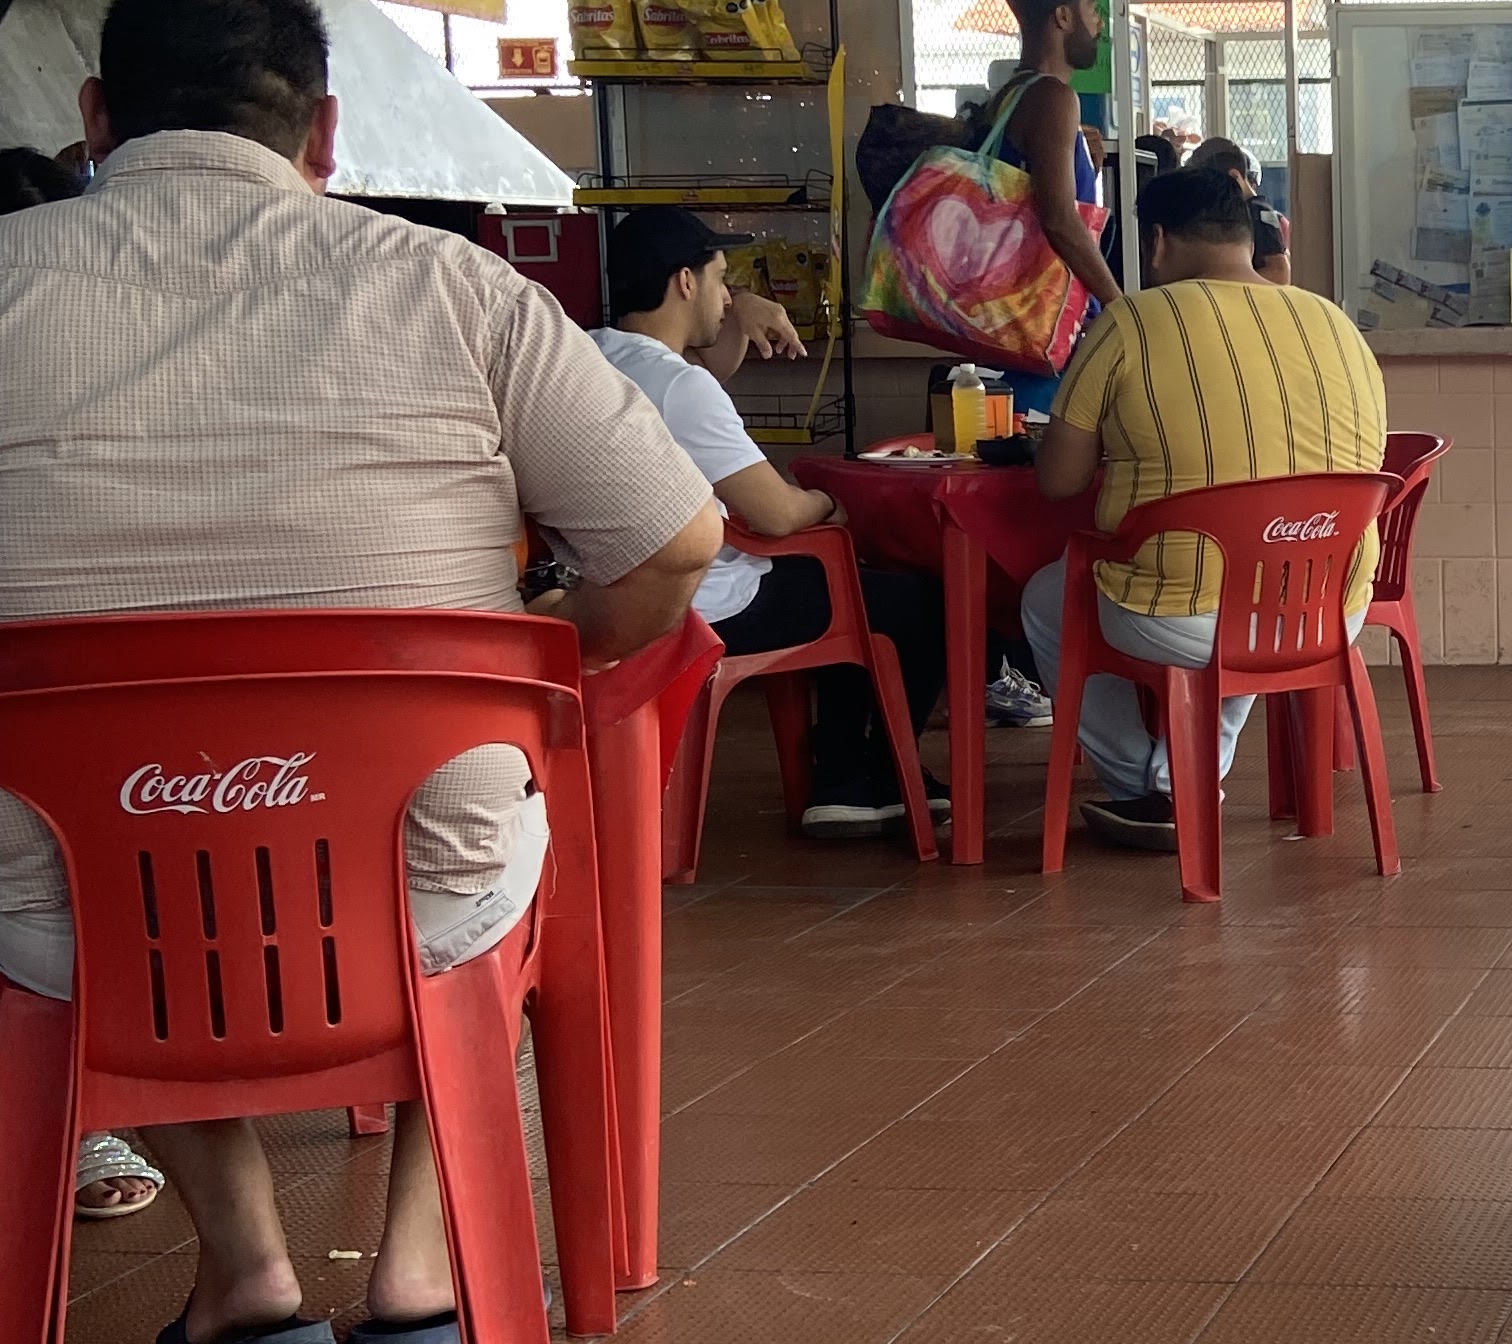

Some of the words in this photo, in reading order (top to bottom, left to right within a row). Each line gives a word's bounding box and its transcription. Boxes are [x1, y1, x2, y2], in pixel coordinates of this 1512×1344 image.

[571, 8, 615, 24] Sabritas
[1263, 510, 1340, 543] Coca-Cola
[119, 751, 317, 815] Coca-Cola
